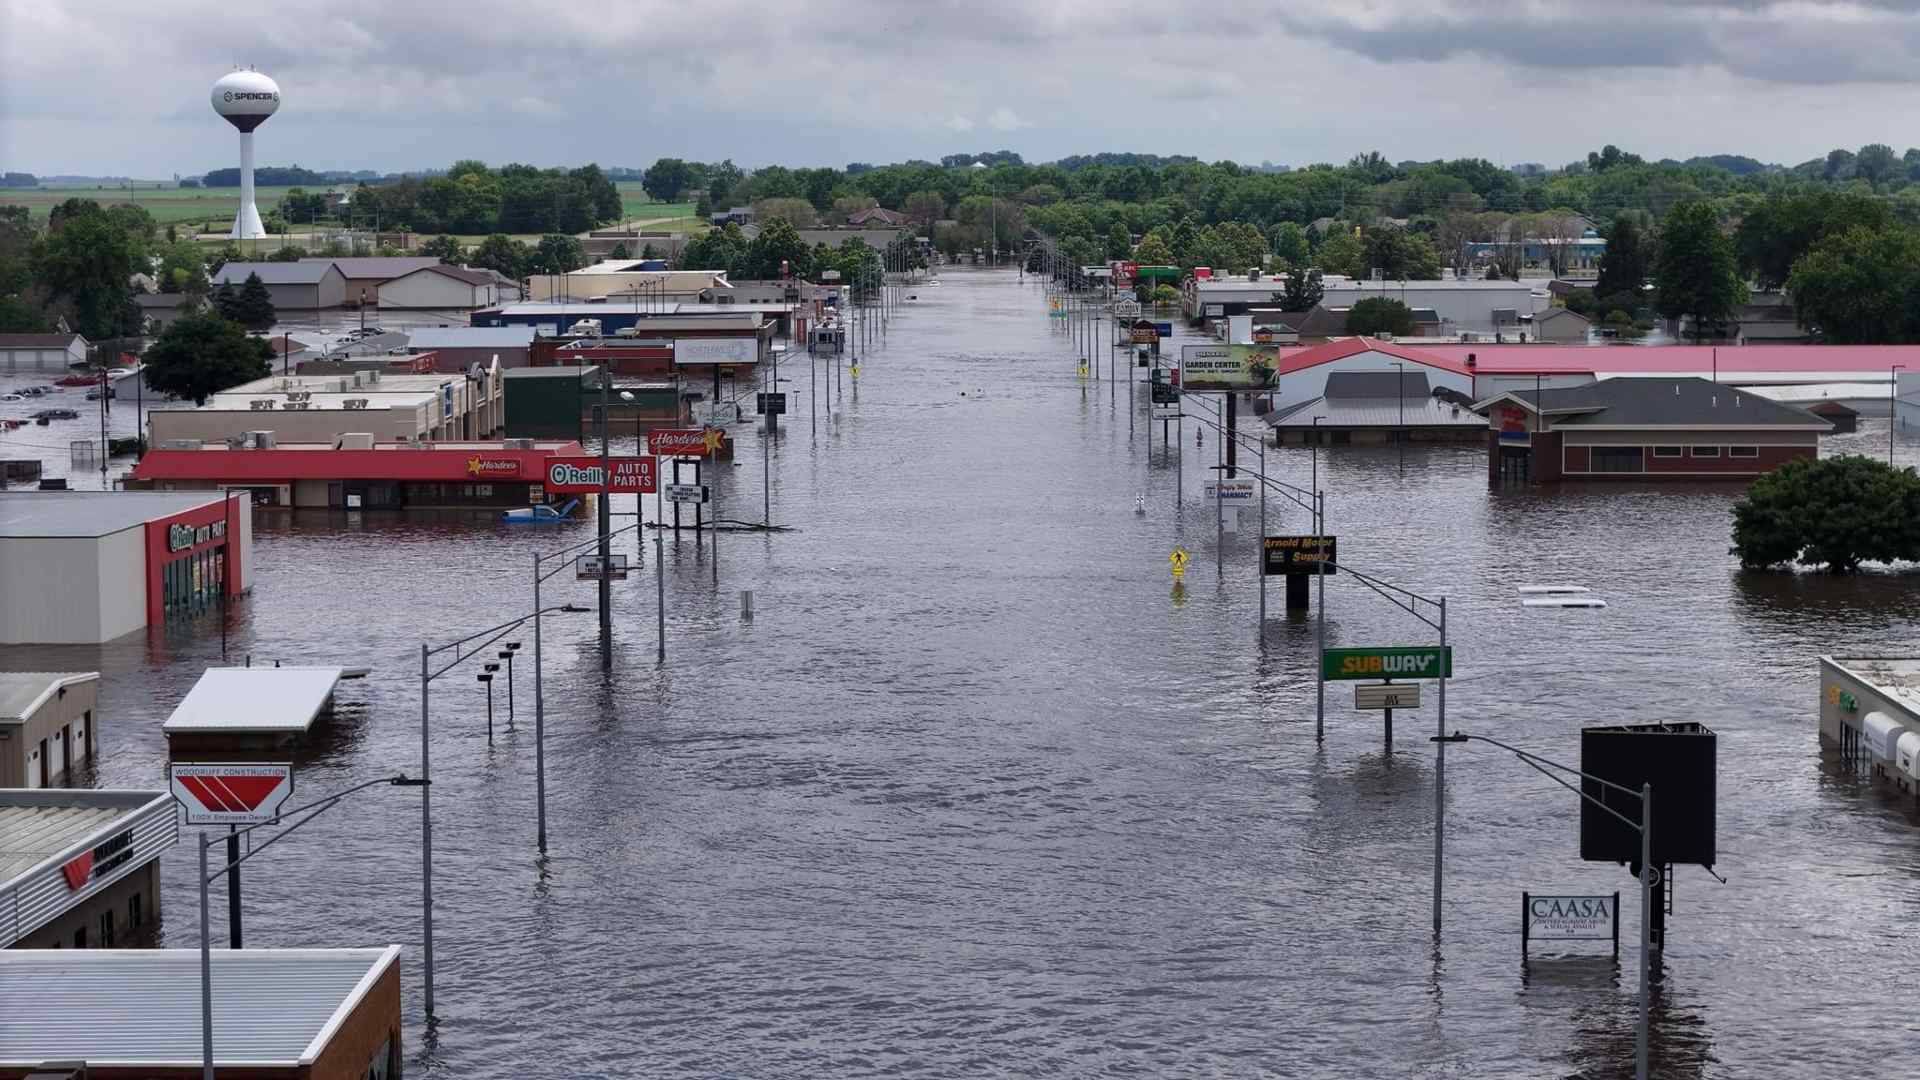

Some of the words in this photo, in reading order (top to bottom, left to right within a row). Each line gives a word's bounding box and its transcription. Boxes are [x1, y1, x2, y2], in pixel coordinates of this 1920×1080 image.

[234, 92, 273, 101] SPENCER
[1184, 361, 1213, 369] GARDEN
[1214, 361, 1241, 369] CENTER
[617, 463, 649, 474] AUTO
[614, 475, 652, 487] PARTS
[212, 519, 226, 539] PART
[1263, 538, 1298, 549] Arnold
[1343, 655, 1435, 673] SUBWAY
[175, 768, 221, 776] WOODRUFF
[223, 768, 287, 776] CONSTRUCTION
[1531, 899, 1610, 918] CAASA
